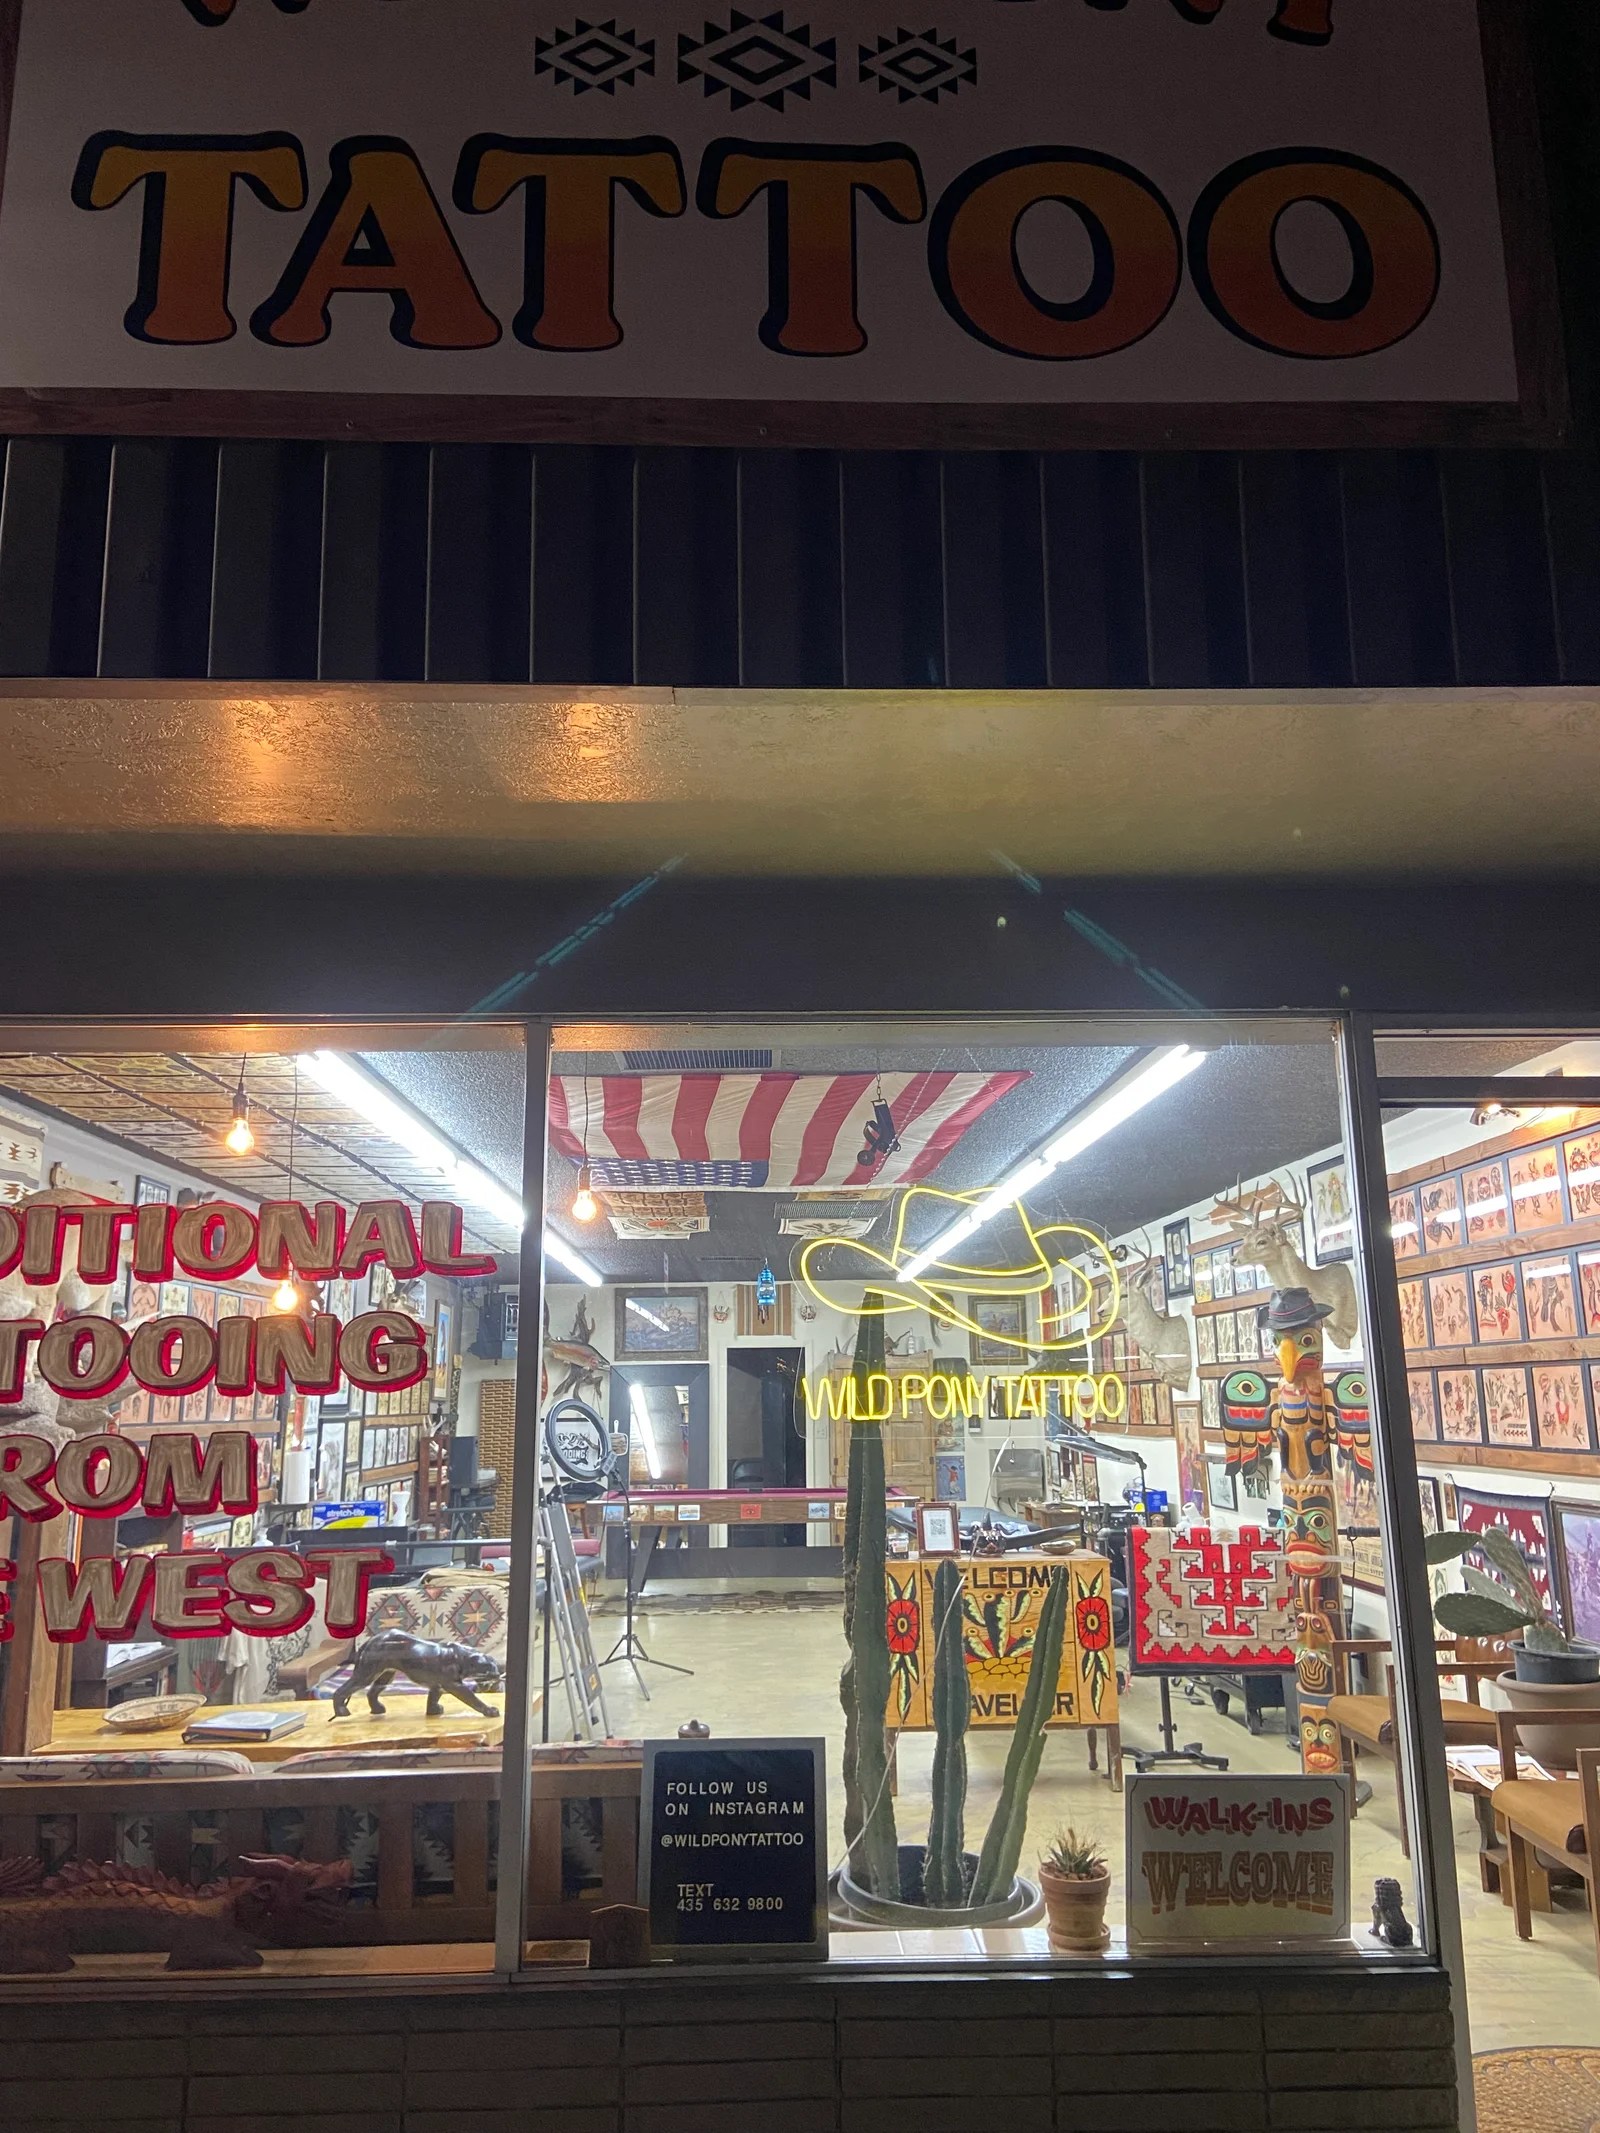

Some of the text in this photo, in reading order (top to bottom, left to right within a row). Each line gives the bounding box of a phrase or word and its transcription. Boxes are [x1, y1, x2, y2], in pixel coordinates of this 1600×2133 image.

[70, 130, 1441, 361] TATTOO
[802, 1374, 1126, 1421] WILD PONY TATTOO
[924, 1565, 1056, 1590] LCOM
[37, 1549, 394, 1643] WEST
[667, 1781, 768, 1796] FOLLOW US
[665, 1801, 804, 1816] ON INSTAGRAM
[1144, 1796, 1335, 1837] WALK-INS
[661, 1832, 804, 1848] @WILDPONYTATTOO
[677, 1883, 715, 1897] TEXT
[1141, 1850, 1335, 1916] WELCOME
[677, 1897, 783, 1912] 435 632 9800
